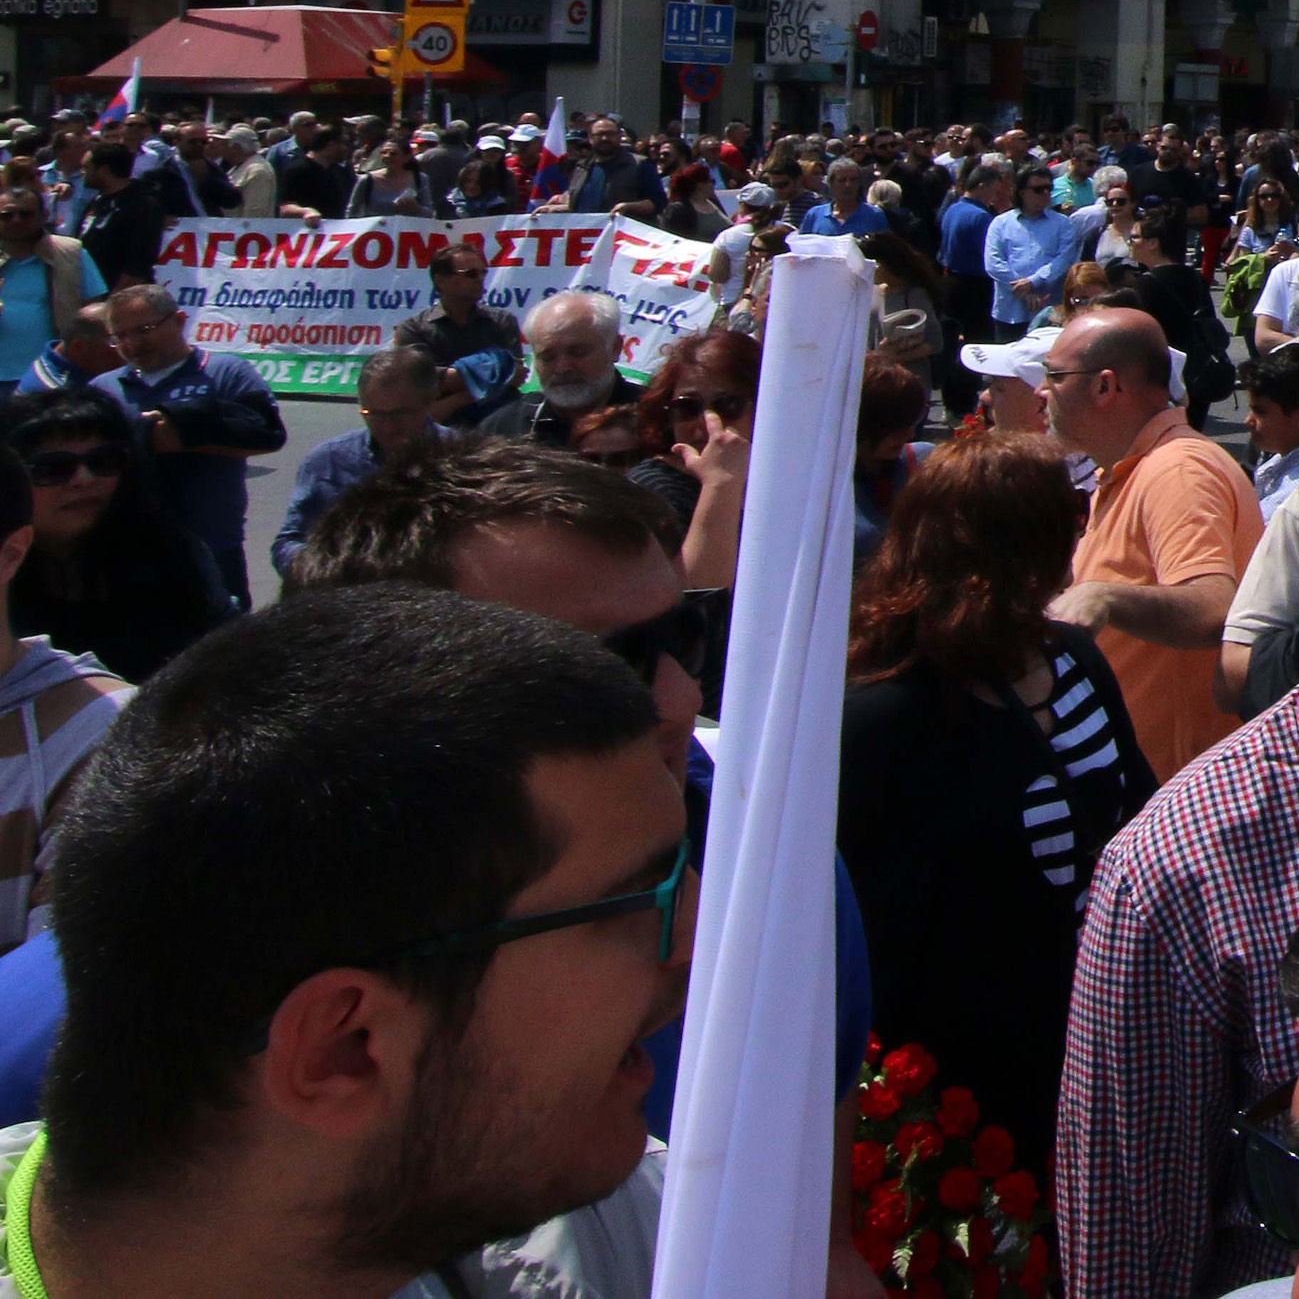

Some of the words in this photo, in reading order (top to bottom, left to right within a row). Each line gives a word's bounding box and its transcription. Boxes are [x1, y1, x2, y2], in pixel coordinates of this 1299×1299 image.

[421, 35, 448, 52] 40
[178, 285, 206, 306] τη
[214, 281, 355, 314] διασφάλιση
[365, 287, 421, 310] των
[629, 298, 688, 334] μας
[195, 321, 242, 343] την
[246, 316, 382, 349] προάσπιση
